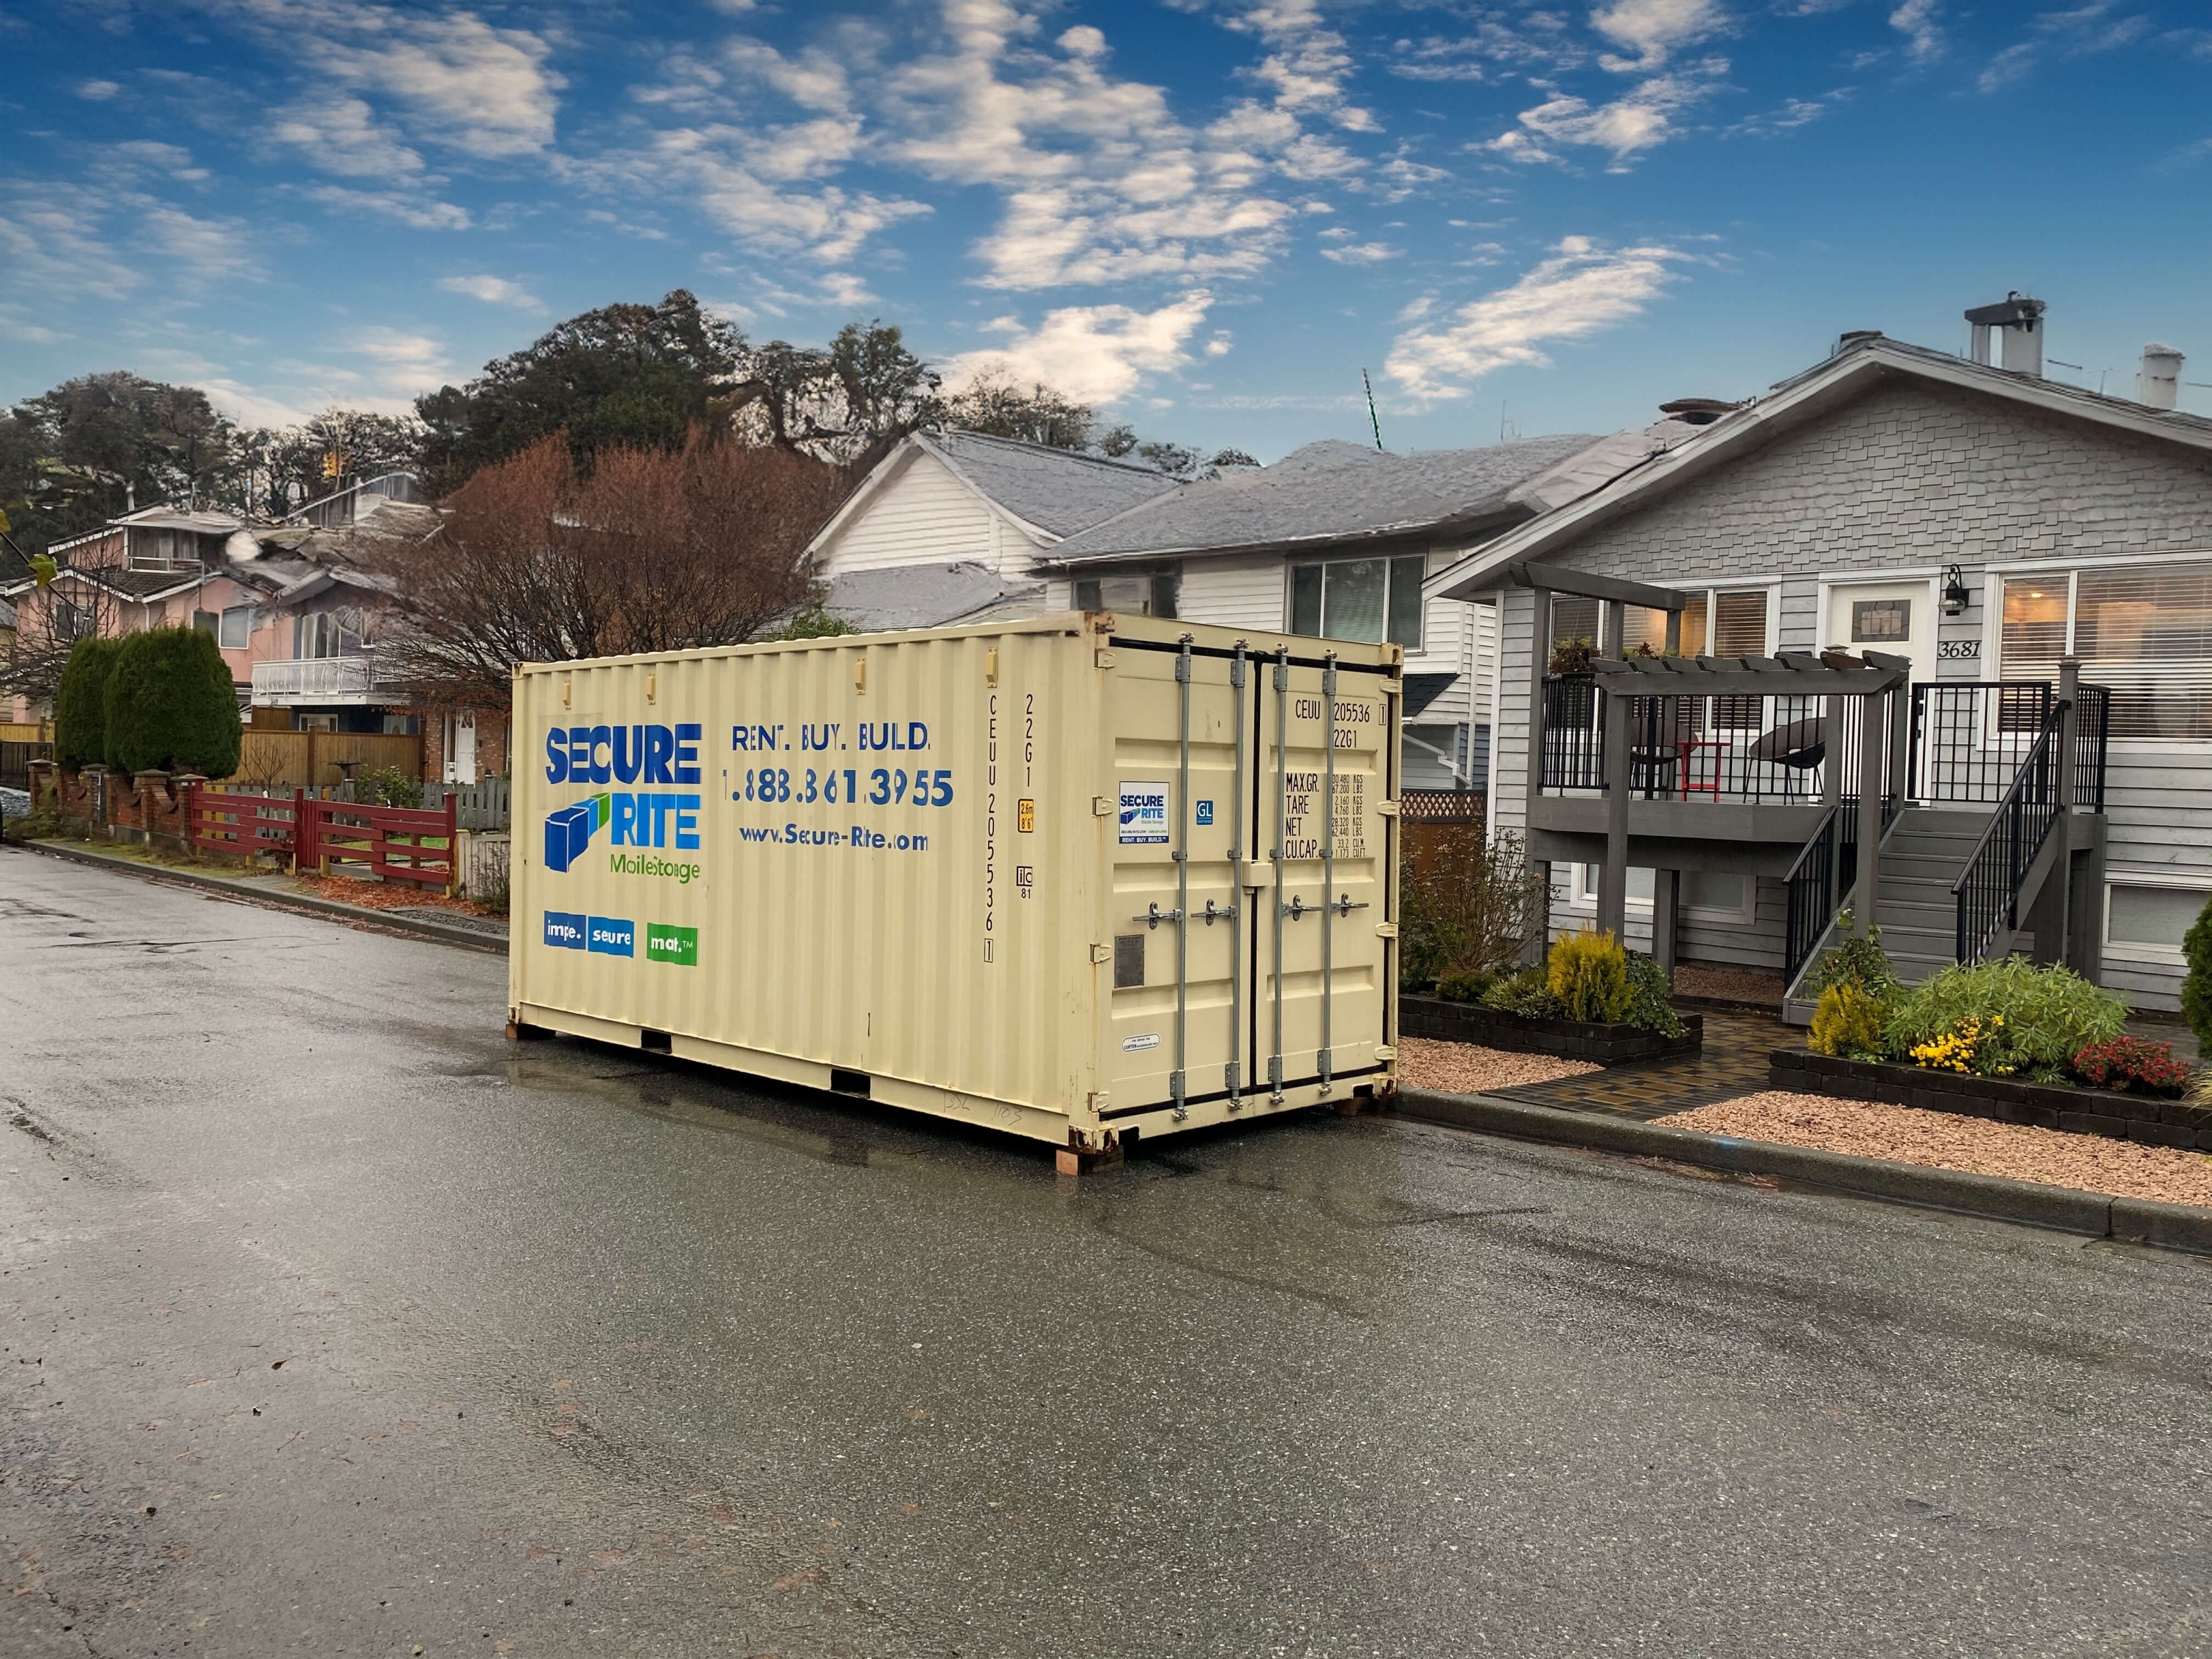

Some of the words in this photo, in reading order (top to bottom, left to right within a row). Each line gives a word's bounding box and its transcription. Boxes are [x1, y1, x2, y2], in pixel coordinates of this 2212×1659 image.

[1938, 641, 1980, 658] 3681
[1295, 699, 1321, 720] CEUU
[1334, 703, 1370, 723] 205536
[732, 725, 790, 751] RENT.
[801, 723, 846, 751] BUY.
[859, 722, 931, 751] BUILD.
[1334, 728, 1357, 748] 22G1
[546, 723, 703, 785] SECURE
[1286, 773, 1319, 792] MAX.GR.
[1332, 774, 1350, 784] 30.480
[1353, 774, 1363, 784] KGS
[1332, 785, 1350, 794] 67.200
[1353, 785, 1363, 794] LBS
[1120, 795, 1164, 807] SECURE
[1197, 802, 1212, 817] GL
[1286, 796, 1310, 814] TARE
[1335, 796, 1349, 805] 2.160
[1353, 796, 1363, 805] KGS
[1141, 808, 1164, 818] RITE
[1335, 806, 1349, 815] 4.760
[1353, 806, 1363, 815] LBS
[611, 793, 700, 849] RITE
[1285, 817, 1302, 836] NET
[1332, 817, 1349, 827] 28.320
[1353, 817, 1363, 826] KGS
[1332, 827, 1349, 837] 62.440
[1353, 827, 1363, 836] LBS
[1285, 840, 1318, 859] CU.CAP.
[1338, 838, 1349, 849] 33.2
[986, 793, 995, 931] 205536
[1021, 888, 1031, 899] 81
